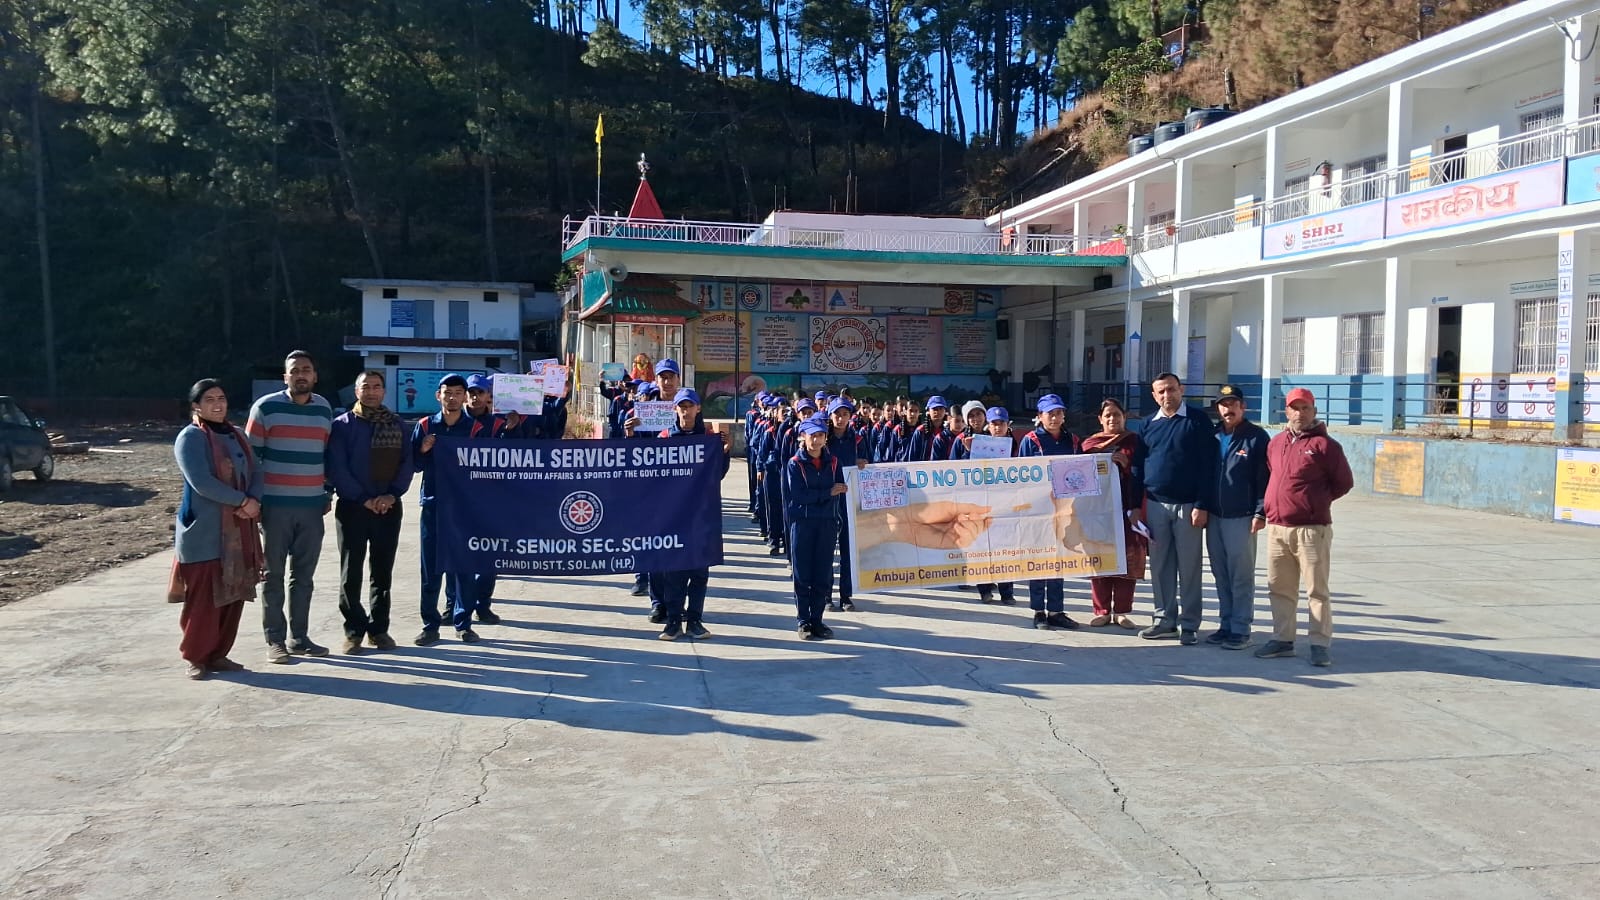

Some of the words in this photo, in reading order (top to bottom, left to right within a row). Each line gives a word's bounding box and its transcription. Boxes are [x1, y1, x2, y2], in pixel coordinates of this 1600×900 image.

[1401, 182, 1518, 226] राजकीय
[1302, 223, 1343, 239] SHRI
[457, 448, 544, 468] NATIONAL
[550, 448, 626, 468] SERVICE
[632, 444, 704, 467] SCHEME
[470, 471, 505, 480] (MINISTRY
[507, 472, 517, 480] OF
[519, 472, 542, 480] YOUTH
[545, 472, 574, 480] AFFAIRS
[576, 472, 582, 480] &
[584, 471, 611, 479] SPORTS
[624, 470, 638, 478] THE
[640, 469, 660, 478] GOVT.
[661, 468, 670, 477] OF
[672, 468, 693, 477] INDIA)
[932, 469, 957, 487] NO
[961, 465, 1043, 486] TOBACCO
[468, 536, 514, 552] GOVT.
[517, 538, 577, 555] SENIOR
[582, 538, 620, 553] SEC.
[622, 534, 684, 551] SCHOOL
[948, 552, 963, 560] Quit
[964, 551, 993, 559] Tobacco
[1002, 549, 1026, 558] Regain
[1027, 547, 1043, 555] Your
[495, 559, 530, 570] CHANDI
[533, 560, 565, 571] DISTT.
[567, 559, 606, 570] SOLAN
[874, 570, 915, 583] Ambuja
[918, 567, 959, 580] Cement
[961, 564, 1024, 577] Foundation,
[1027, 560, 1078, 572] Darlaghat
[1080, 556, 1102, 568] (HP)
